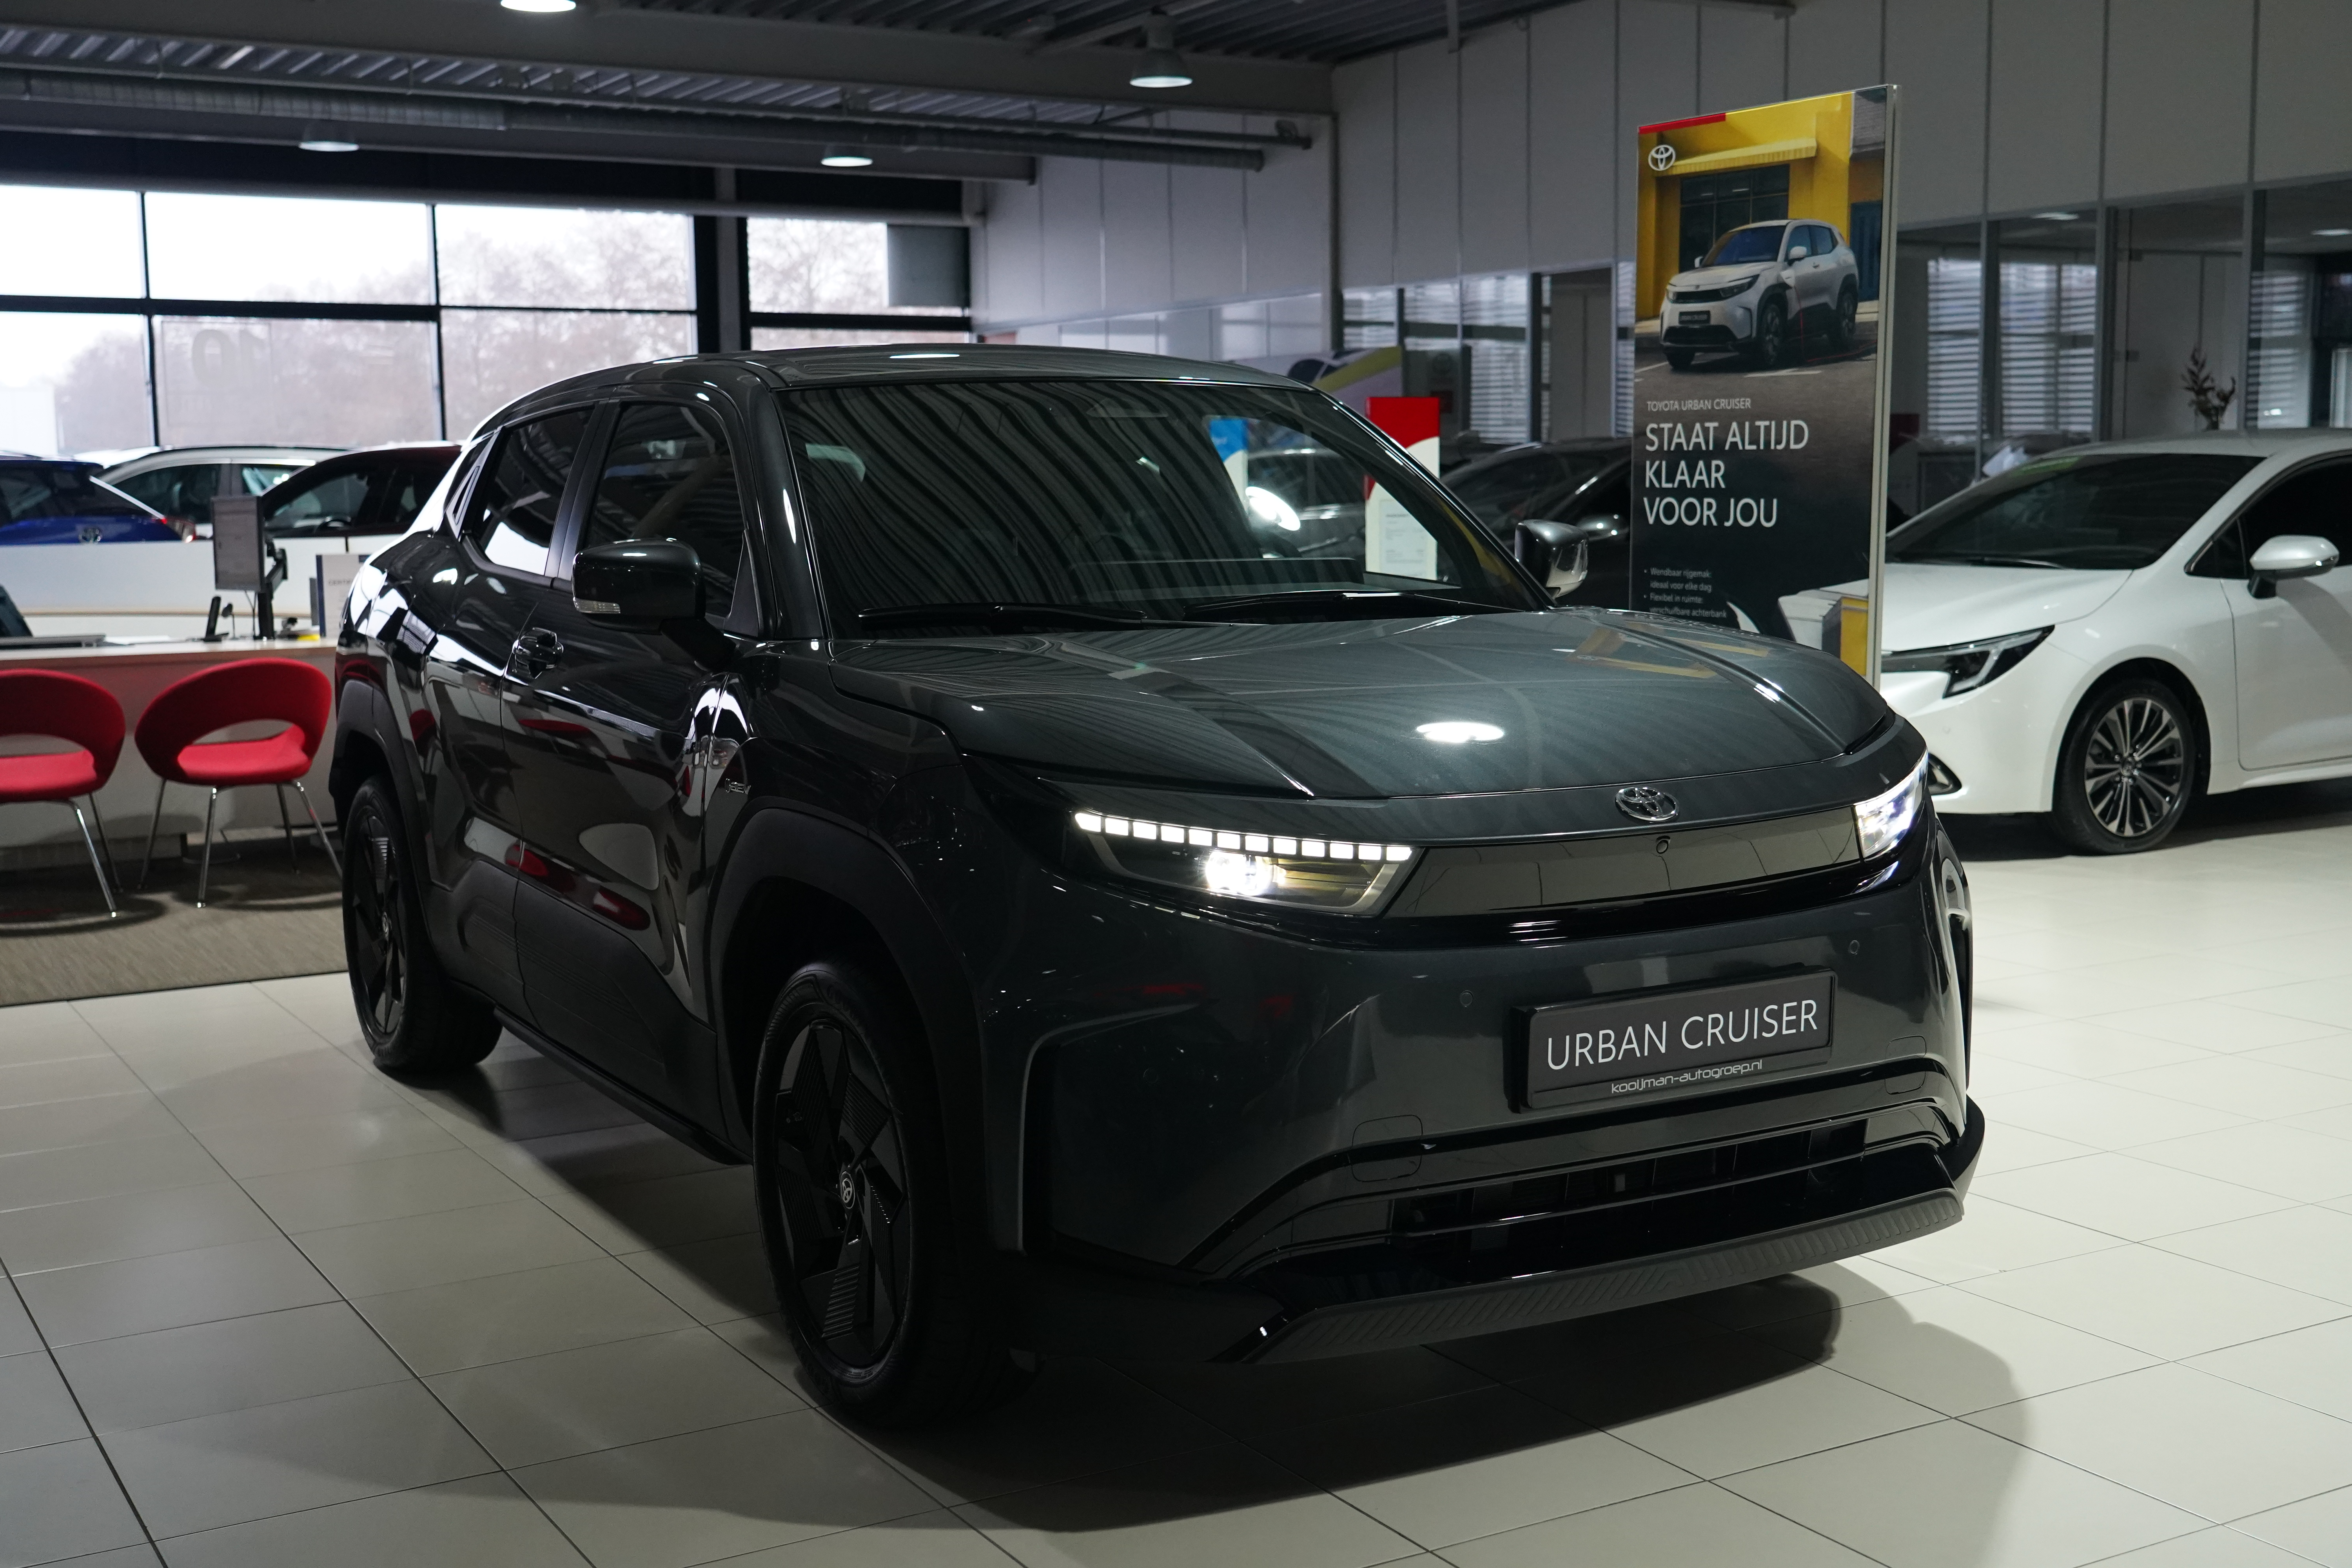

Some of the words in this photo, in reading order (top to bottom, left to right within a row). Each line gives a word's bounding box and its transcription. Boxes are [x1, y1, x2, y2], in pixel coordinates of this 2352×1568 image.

[1647, 401, 1679, 411] TOYOTA
[1682, 399, 1711, 410] URBAN
[1714, 398, 1751, 409] CRUISER
[1646, 422, 1719, 451] STAAT
[1725, 420, 1809, 450] ALTIJD
[1646, 460, 1725, 488] KLAAR
[1643, 497, 1718, 526] VOOR
[1724, 497, 1777, 528] JOU
[1650, 568, 1682, 577] Wendbaar
[1650, 592, 1673, 602] Flexibel
[1699, 583, 1712, 593] dag
[1691, 609, 1726, 618] achterbank
[1547, 1021, 1666, 1070] URBAN
[1681, 999, 1818, 1049] CRUISER
[1611, 1059, 1762, 1094] kooijman-autogroep.nl
